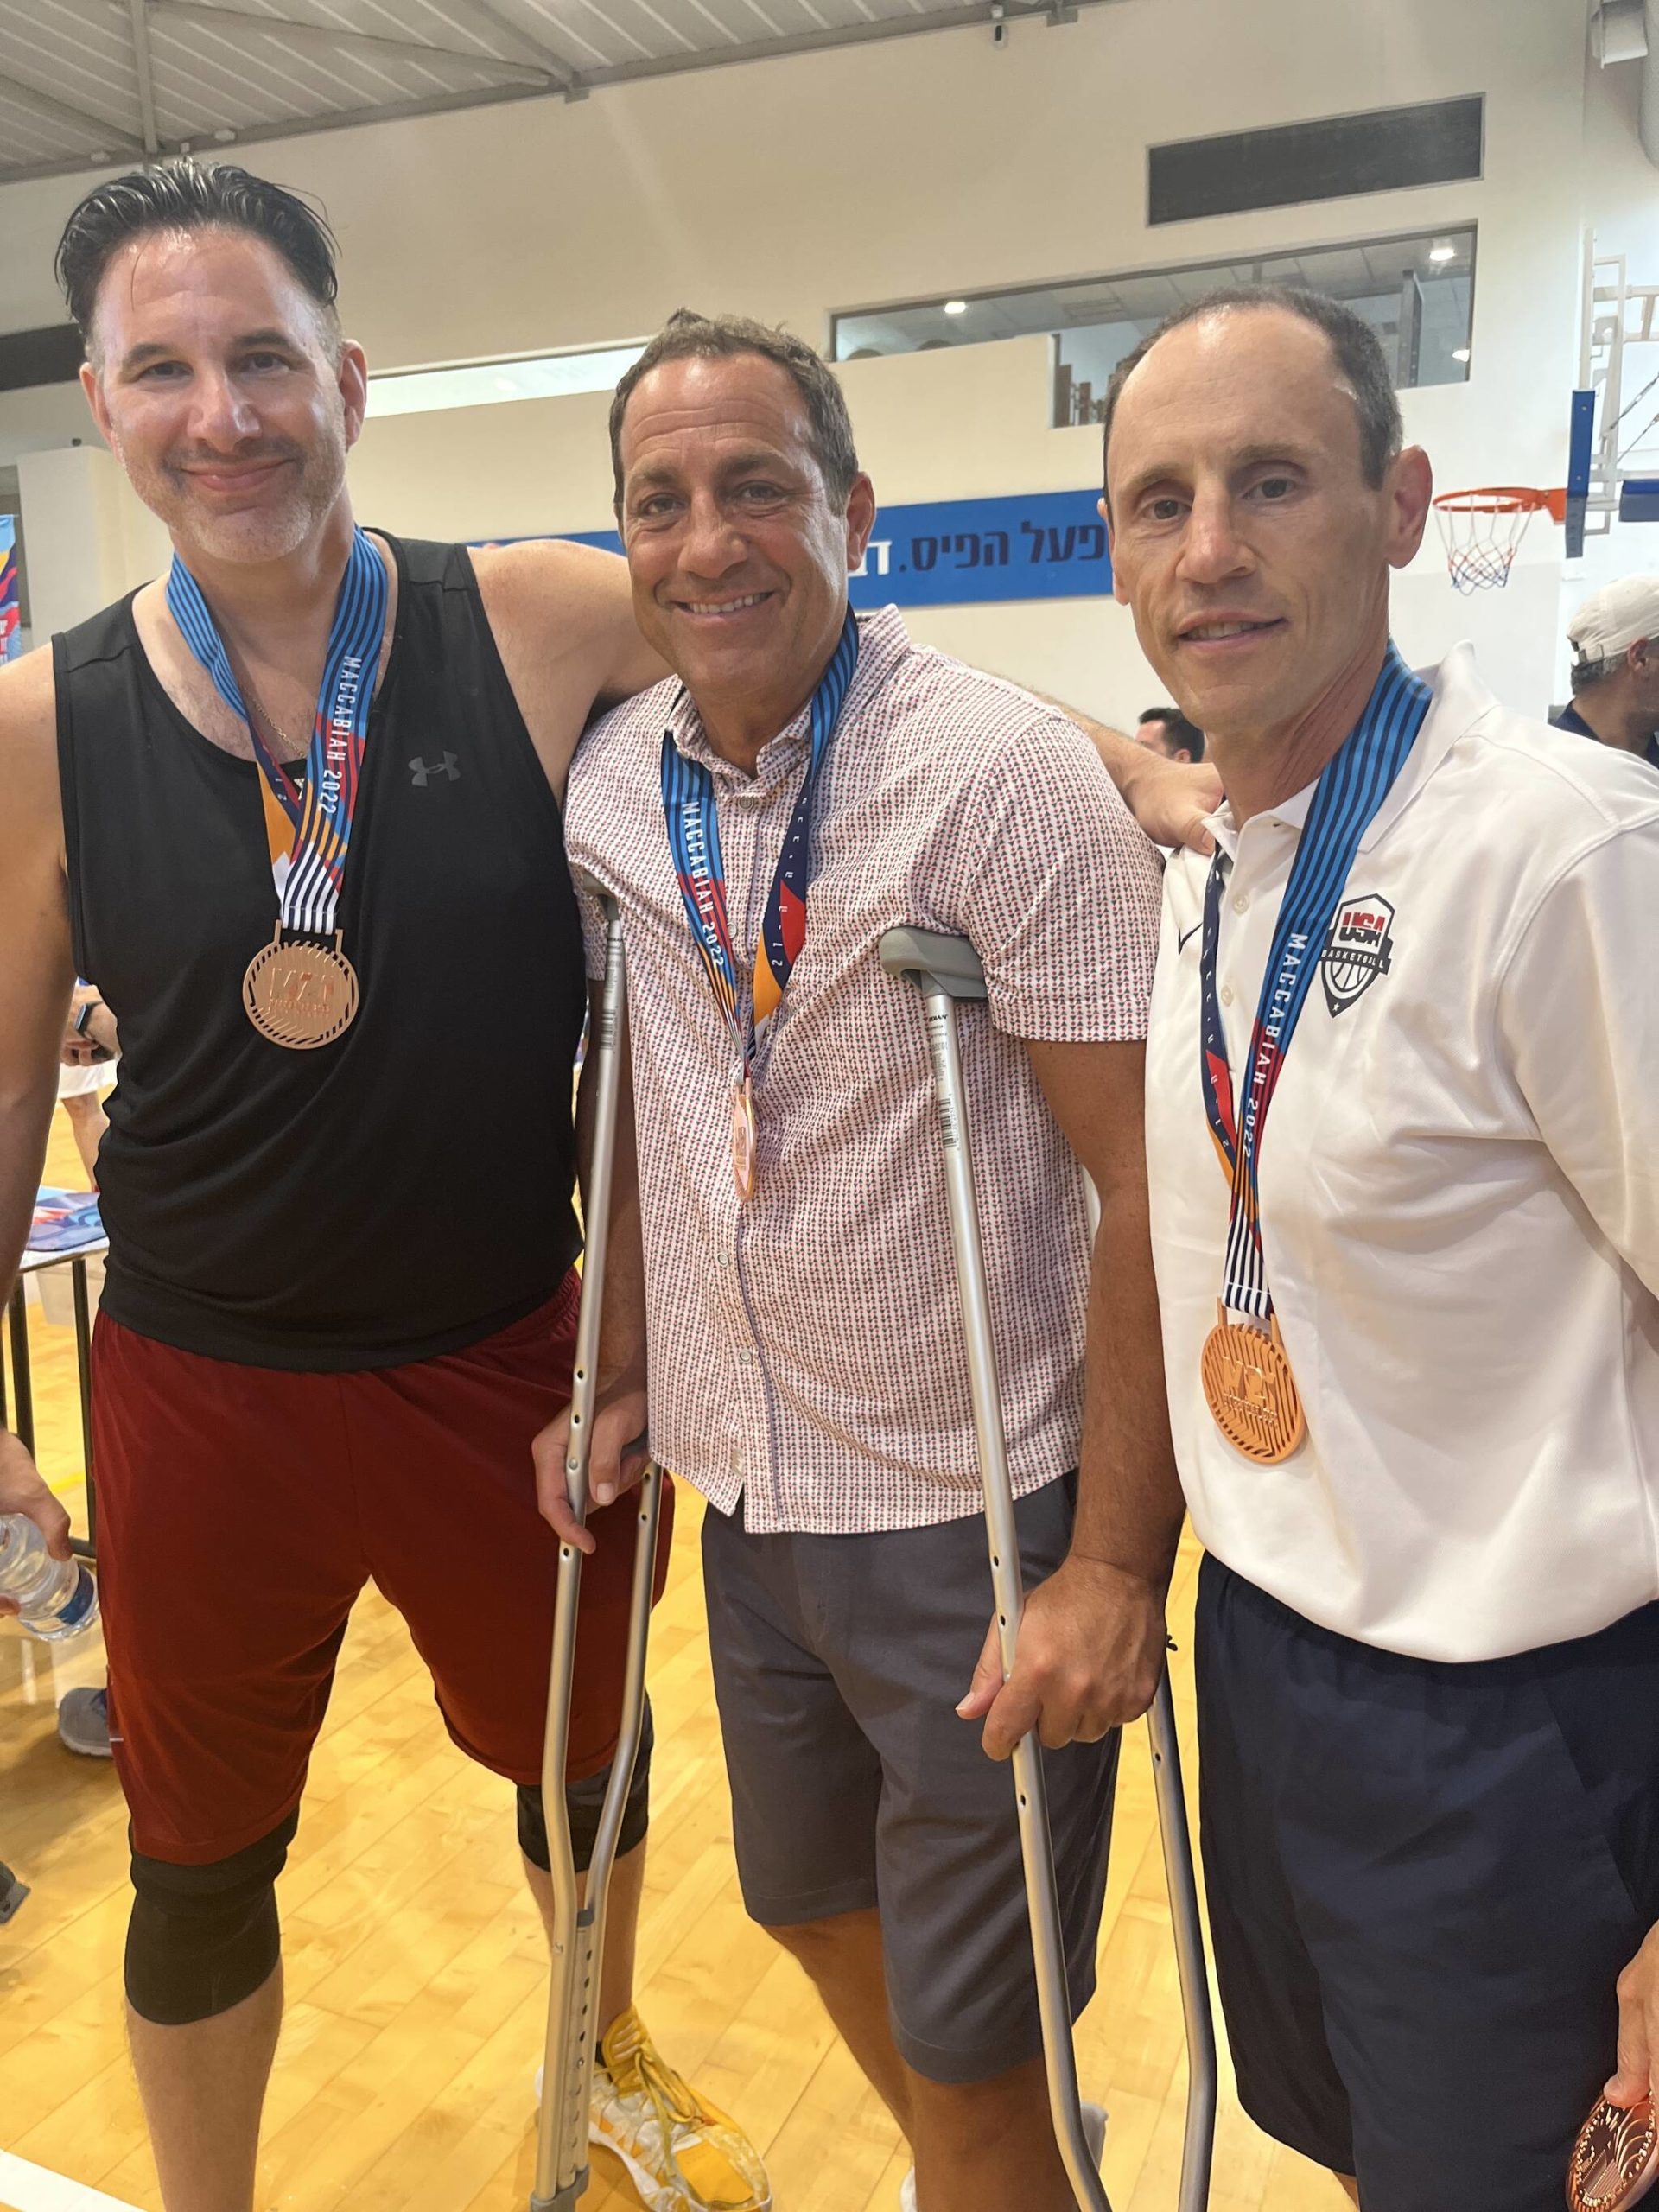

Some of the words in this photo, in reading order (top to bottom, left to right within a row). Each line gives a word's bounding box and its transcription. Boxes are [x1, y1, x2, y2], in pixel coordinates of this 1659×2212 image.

[899, 530, 1009, 573] הפיס.
[1020, 520, 1106, 563] פעל
[327, 655, 363, 761] MACCABIAH
[320, 768, 343, 814] 2022
[682, 800, 715, 914] MACCABIAH
[702, 921, 724, 967] 2022
[1339, 912, 1386, 948] USA
[1321, 949, 1385, 969] BASKETBALL
[1253, 932, 1309, 1086] MACCABIAH
[1242, 1097, 1259, 1159] 2022
